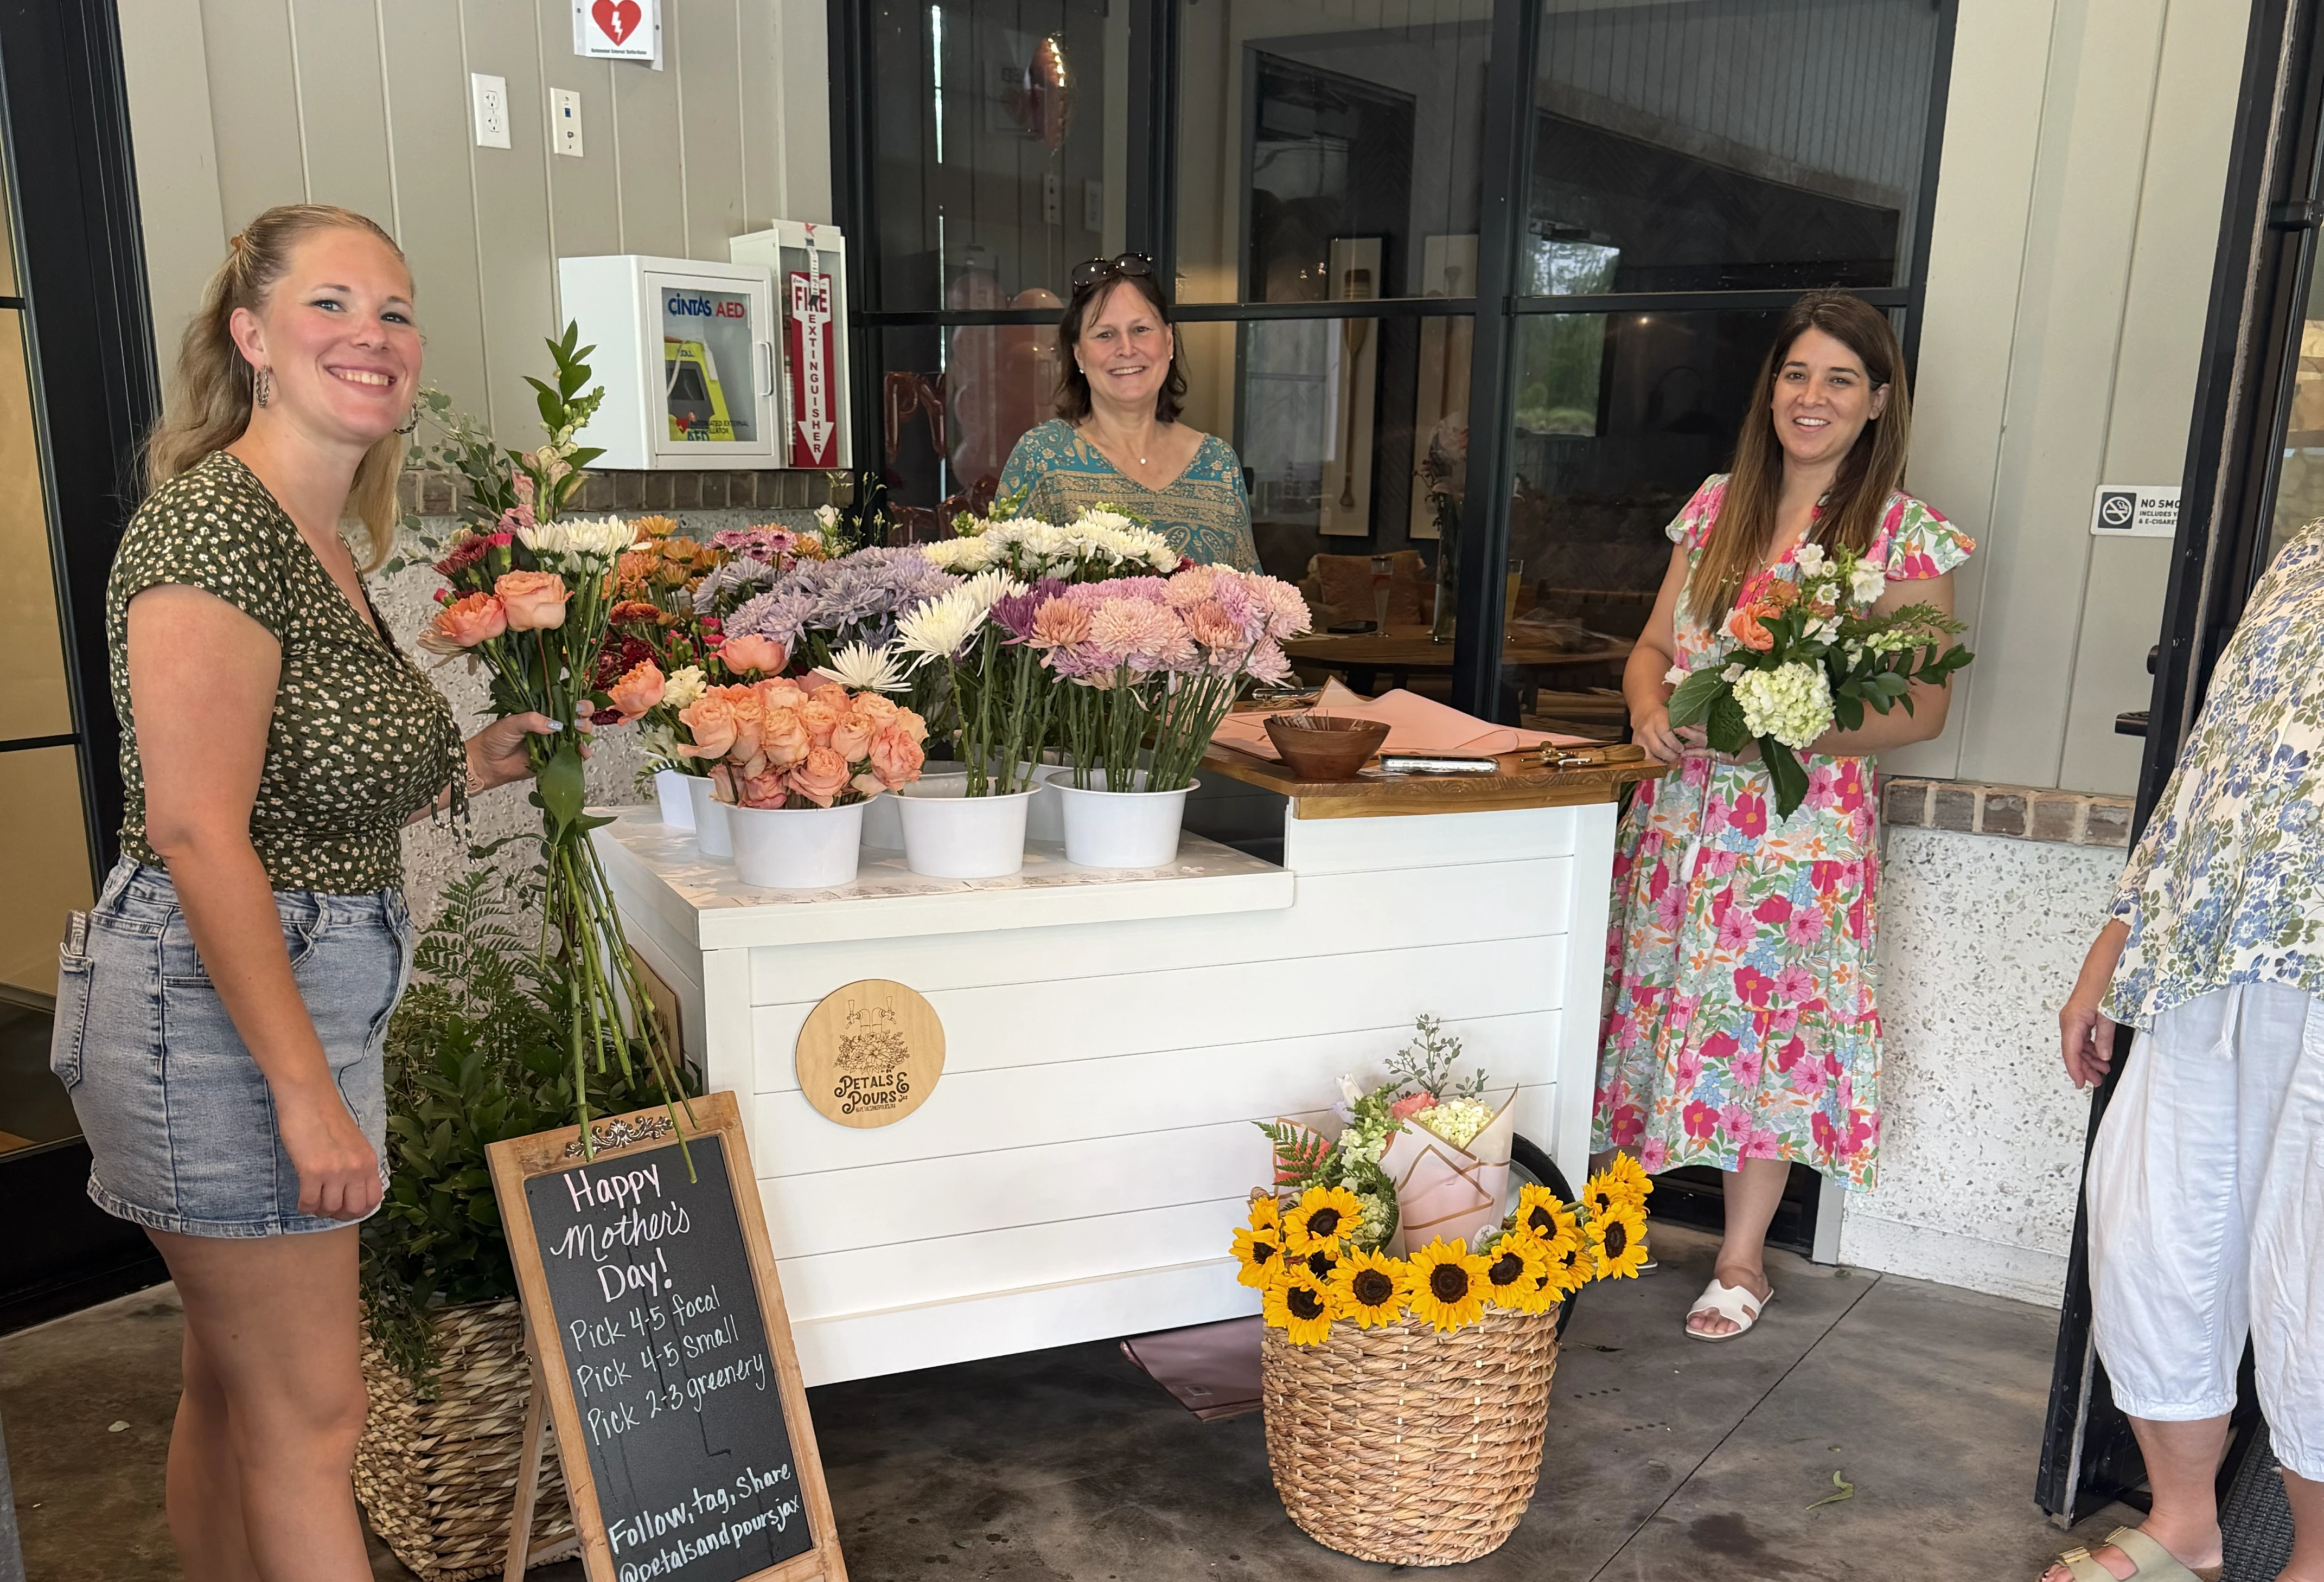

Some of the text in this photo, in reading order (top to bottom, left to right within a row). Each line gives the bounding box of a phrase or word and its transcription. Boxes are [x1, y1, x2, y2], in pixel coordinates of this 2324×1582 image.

[716, 301, 745, 318] AED
[808, 314, 821, 453] EXTINGUISHER
[2141, 499, 2155, 508] NO
[834, 1074, 894, 1098] PETALS
[841, 1090, 897, 1115] POURS
[563, 1164, 661, 1212] Happy
[550, 1201, 690, 1261] Mother's
[597, 1247, 673, 1303] Day!
[570, 1284, 720, 1352] Pick 4-5 focal
[577, 1358, 632, 1398] Pick
[641, 1346, 679, 1372] 4-5
[588, 1353, 766, 1445] Pick 2-3 greenery
